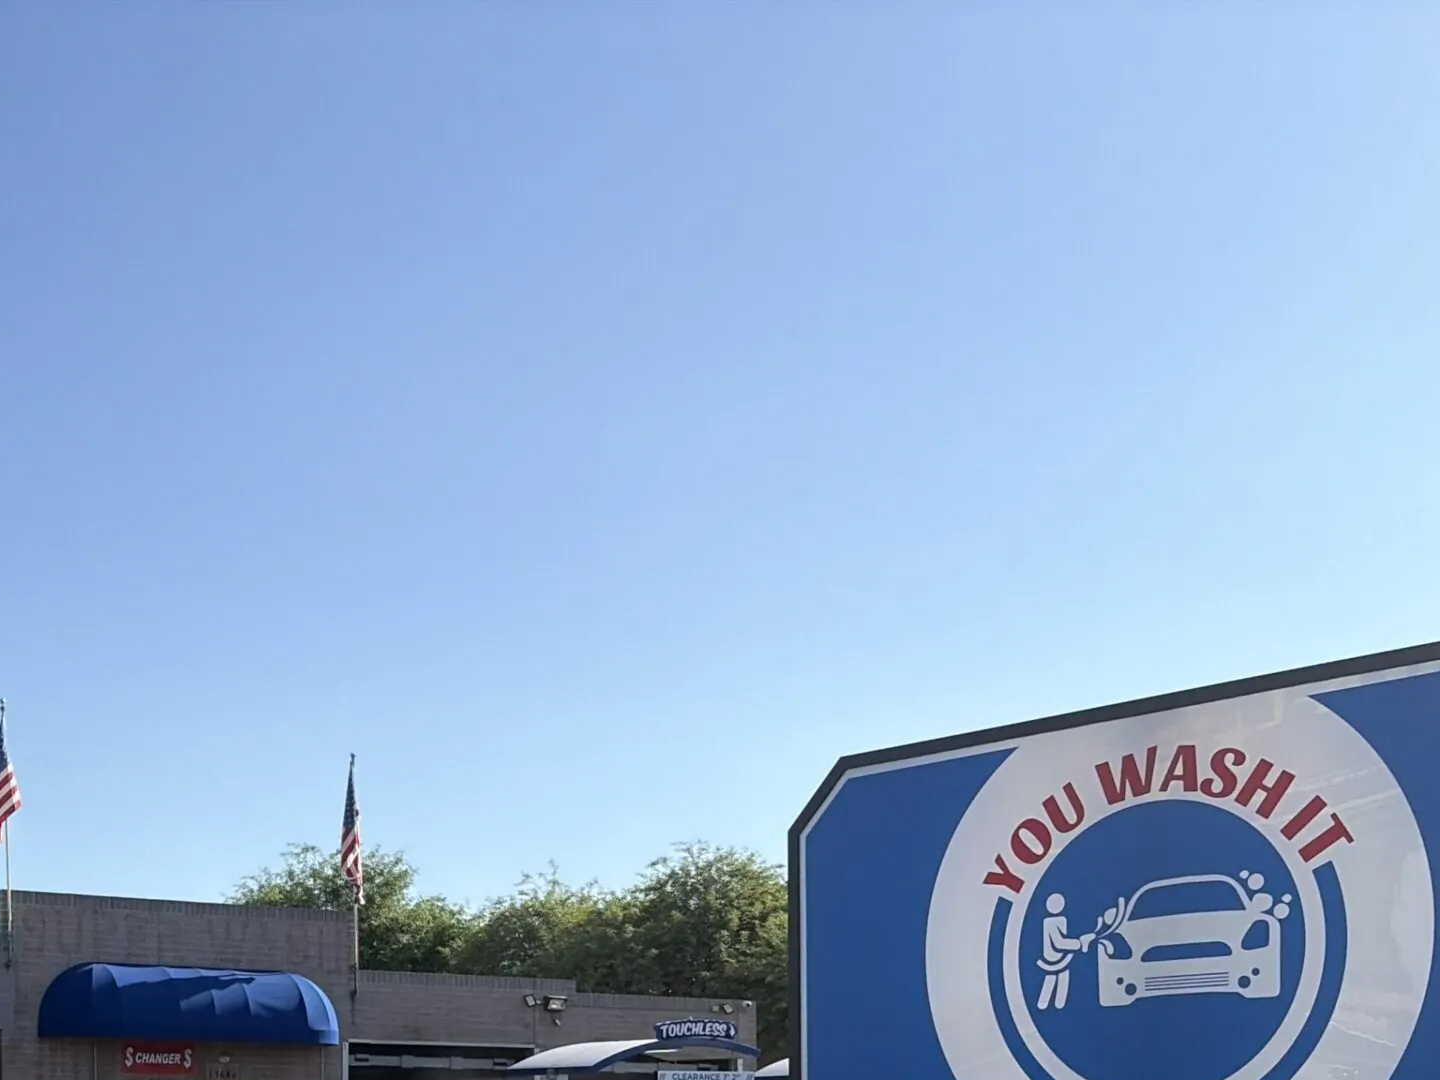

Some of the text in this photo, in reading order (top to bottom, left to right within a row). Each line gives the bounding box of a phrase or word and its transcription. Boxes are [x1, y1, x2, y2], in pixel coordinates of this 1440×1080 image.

[983, 744, 1355, 894] YOU WASH IT
[660, 1022, 727, 1038] TOUCHLESS
[135, 1052, 181, 1065] CHANGER
[672, 1073, 720, 1080] CLEARANCE
